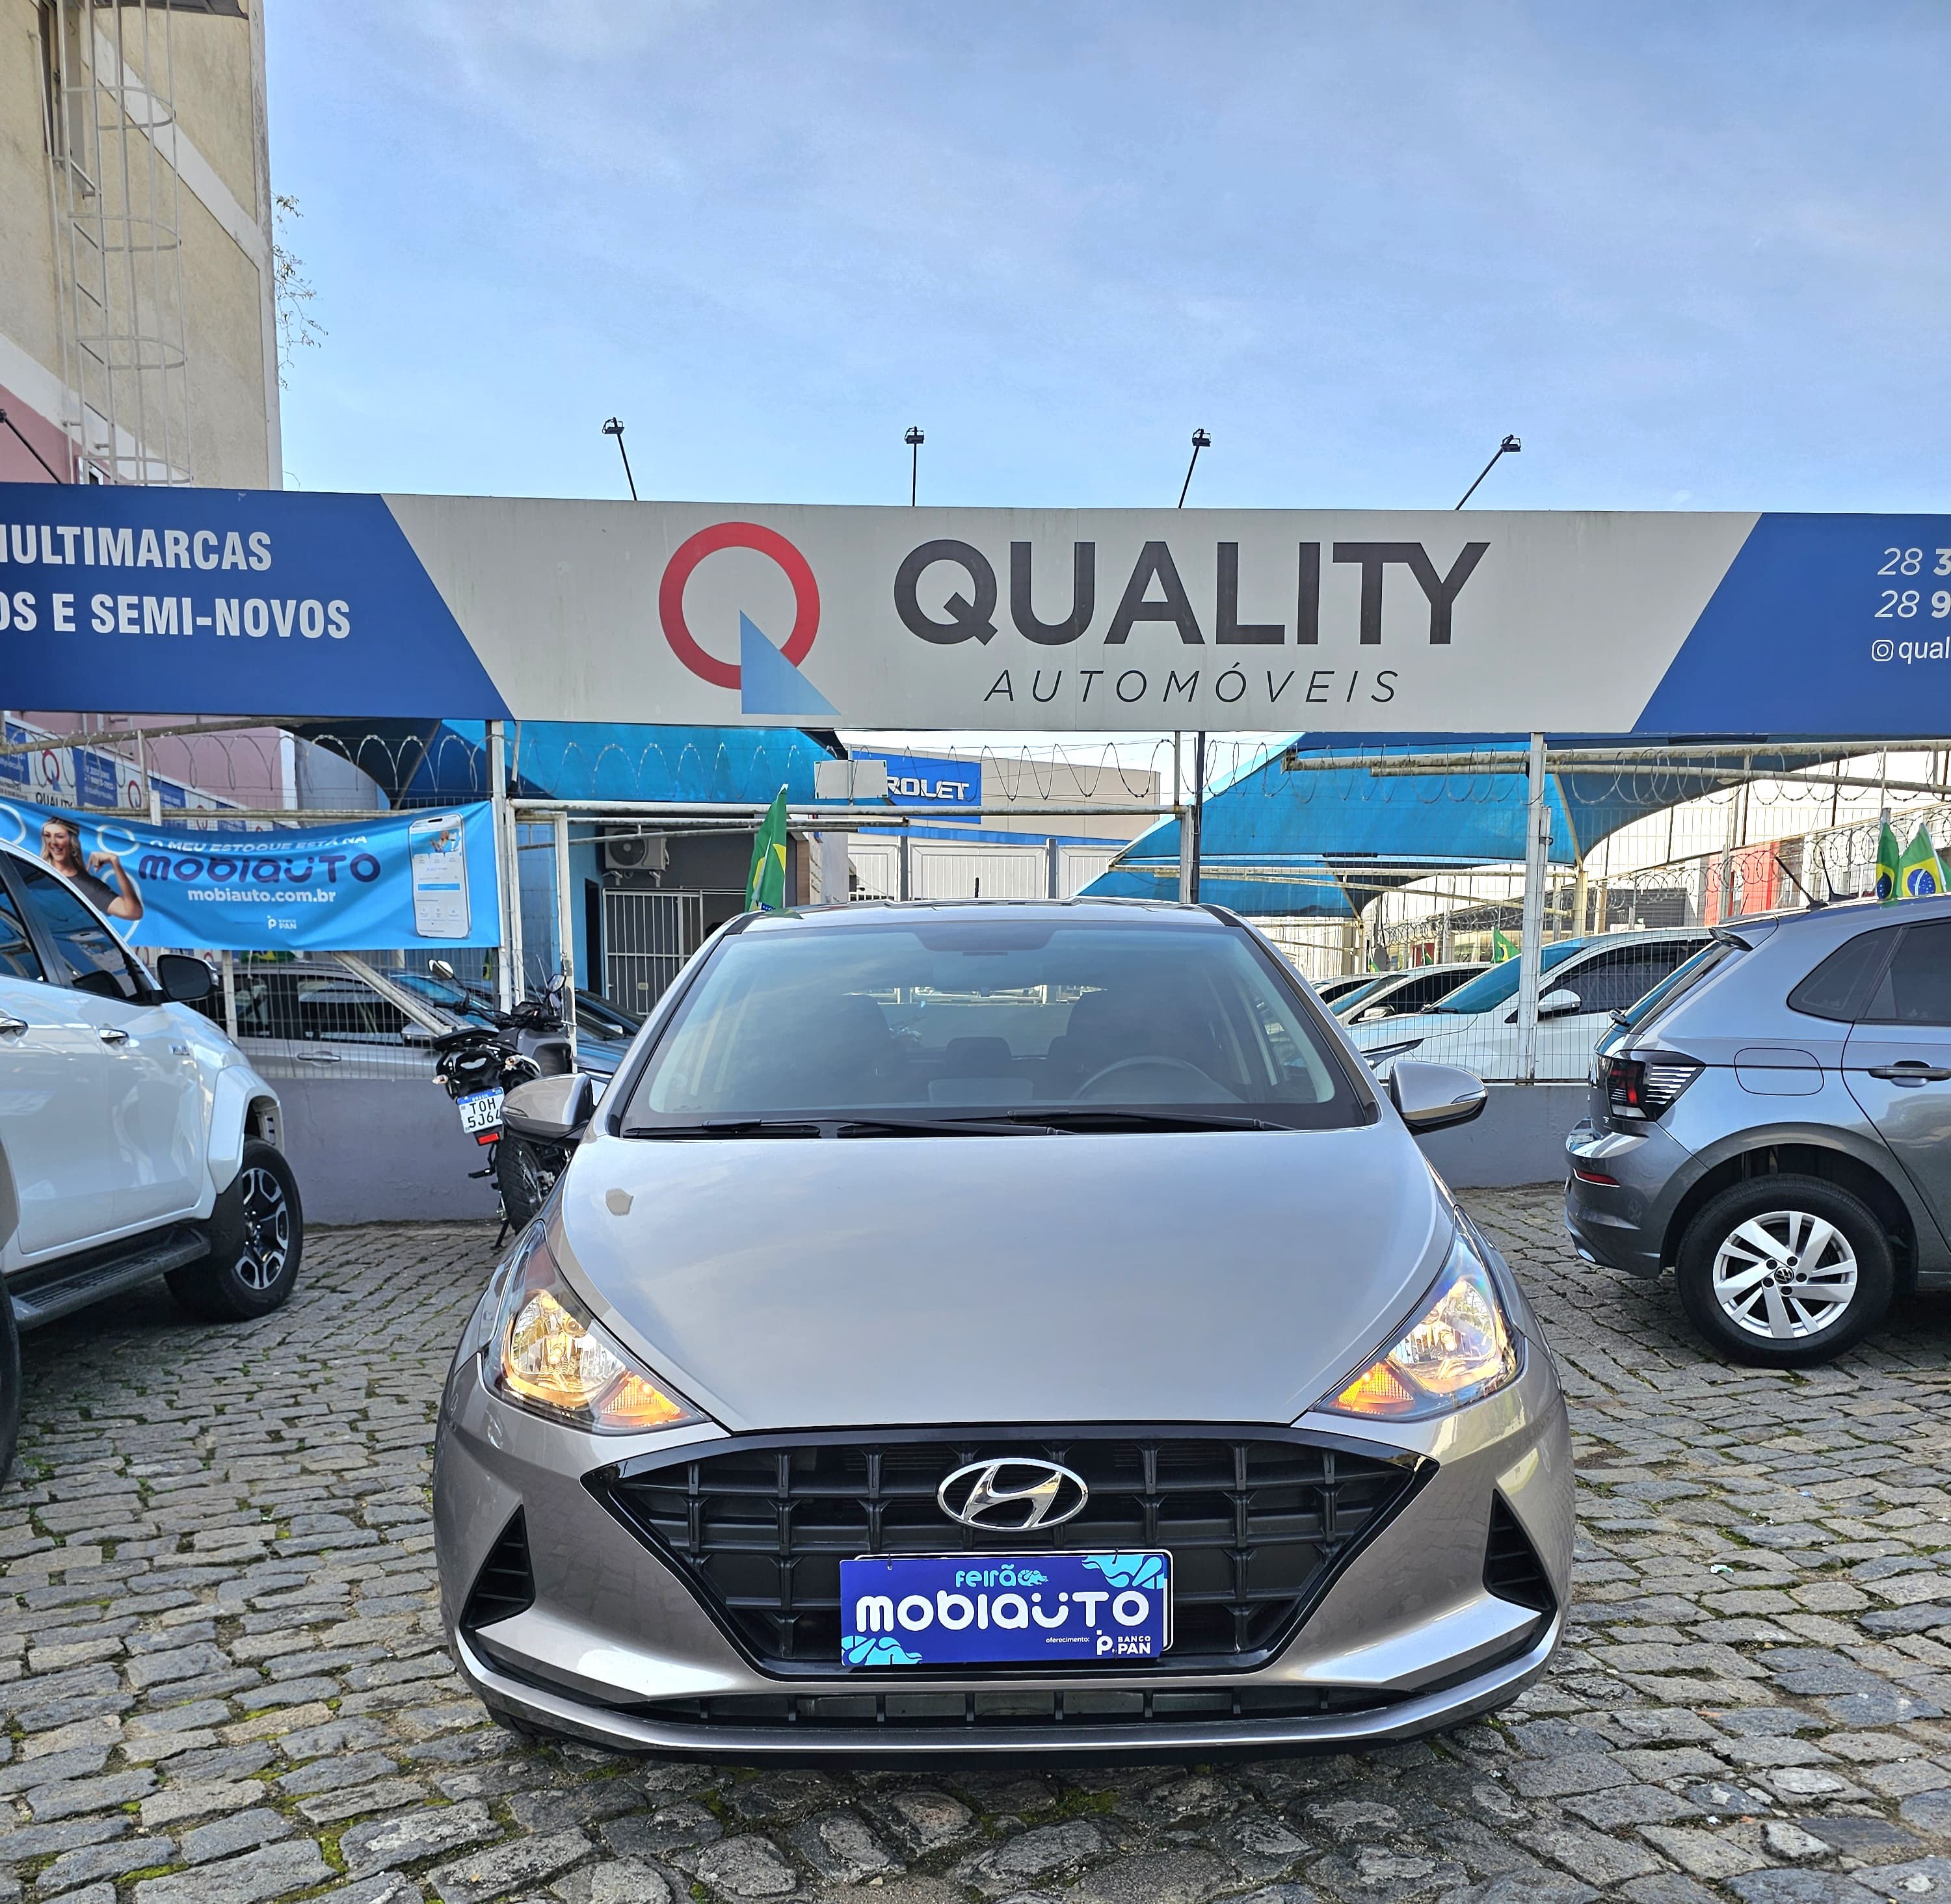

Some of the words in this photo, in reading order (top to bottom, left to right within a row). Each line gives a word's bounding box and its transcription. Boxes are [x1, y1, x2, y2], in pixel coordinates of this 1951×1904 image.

[0, 524, 272, 571] ULTIMARCAS
[1877, 548, 1923, 575] 28
[894, 538, 1491, 646] QUALITY
[1874, 590, 1920, 618] 28
[53, 593, 75, 631] E
[91, 594, 351, 639] SEMI-NOVOS
[984, 662, 1399, 703] AUTOMÓVEIS
[168, 841, 207, 853] MEU
[209, 842, 292, 853] ESTOQUE
[342, 835, 368, 845] NA
[187, 888, 337, 903] mobiauto.com.br
[469, 1098, 496, 1115] TOH
[1117, 1642, 1151, 1655] PAN
